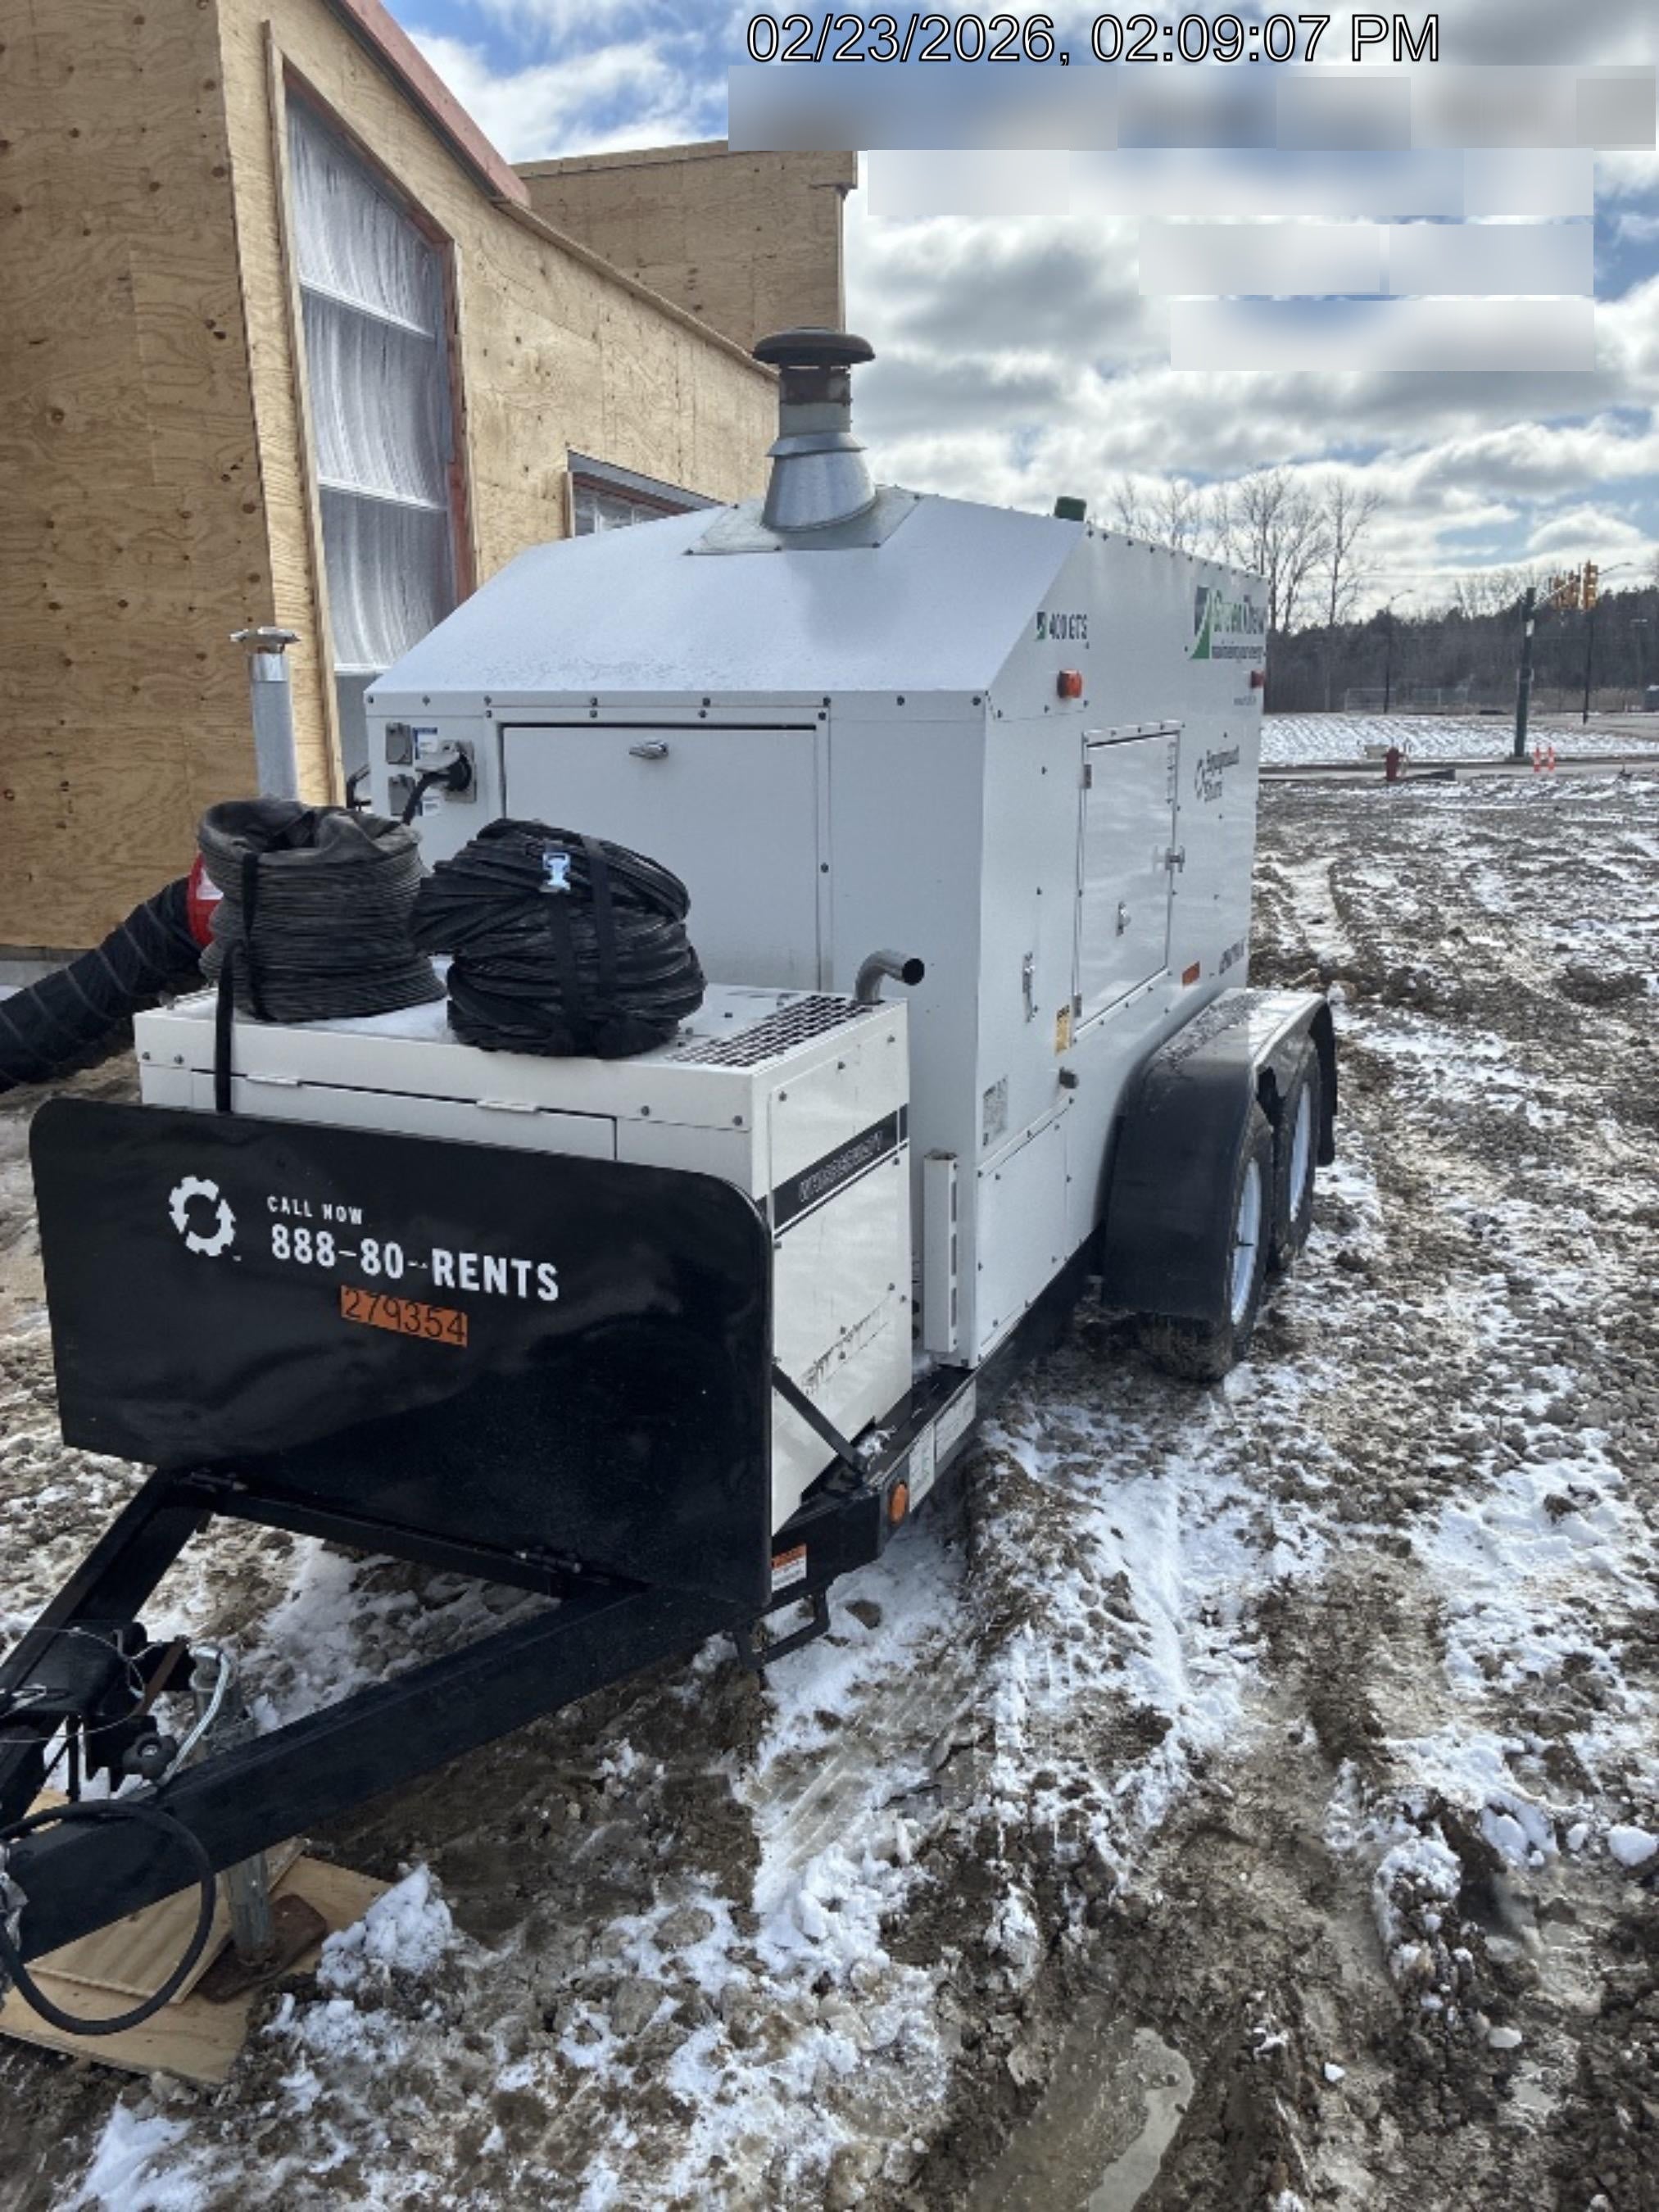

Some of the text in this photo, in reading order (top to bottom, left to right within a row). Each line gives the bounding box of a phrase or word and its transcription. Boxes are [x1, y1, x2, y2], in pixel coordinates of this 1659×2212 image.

[267, 1194, 362, 1225] CALL NOW
[345, 1291, 465, 1344] 279354
